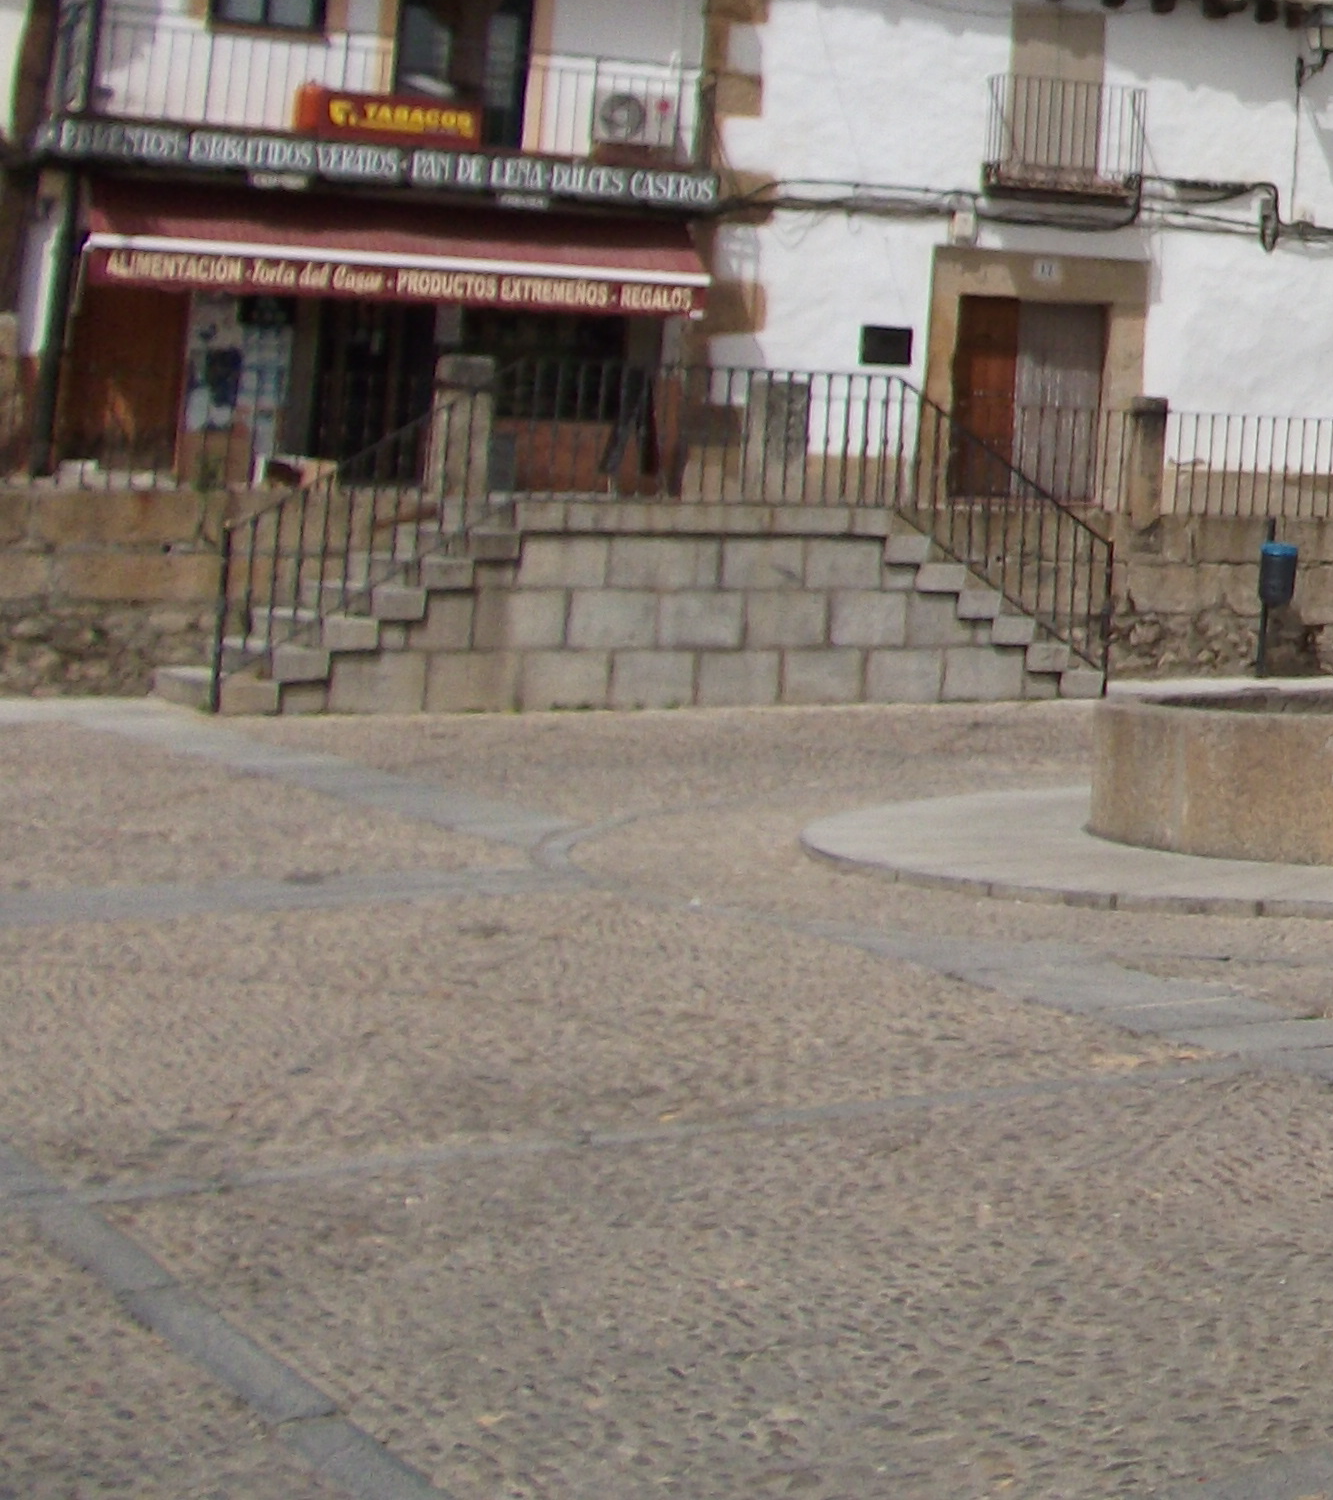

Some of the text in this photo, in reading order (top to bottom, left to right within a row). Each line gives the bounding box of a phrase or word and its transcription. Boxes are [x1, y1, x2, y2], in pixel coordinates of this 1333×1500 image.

[364, 102, 474, 139] TABACOS
[412, 149, 450, 182] PAN
[457, 153, 484, 184] DE
[630, 169, 716, 203] CASEROS
[106, 251, 244, 285] ALIMENTACIÓN
[299, 260, 331, 290] del
[396, 268, 497, 299] PRODUCTOS
[501, 276, 609, 306] EXTREMEÑOS
[620, 282, 693, 311] REGALOS
